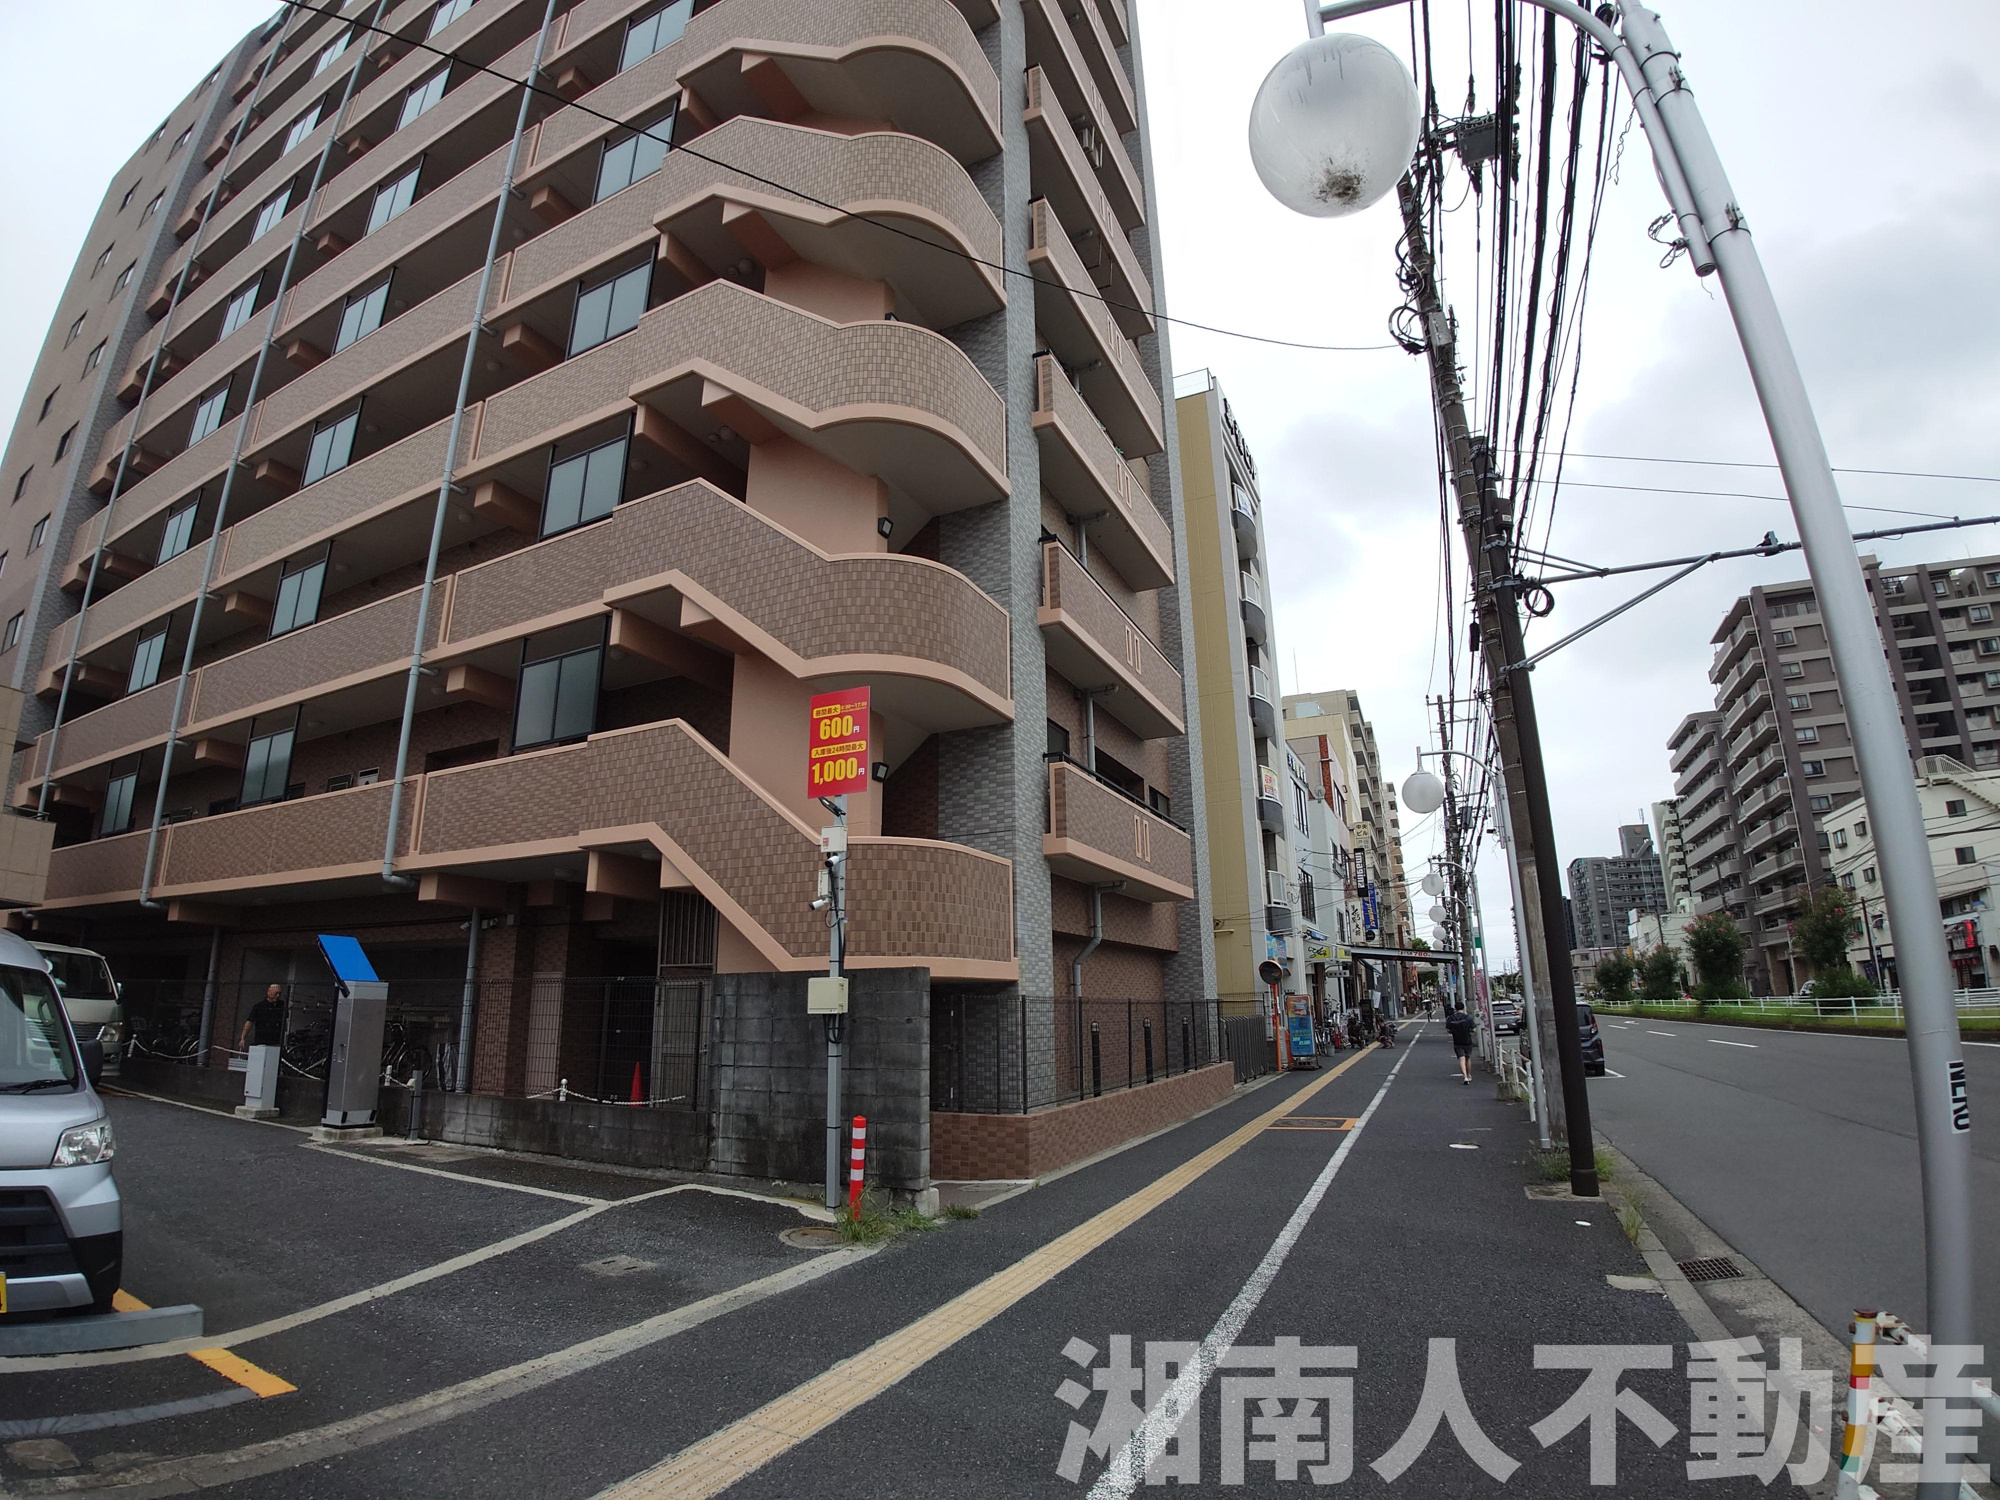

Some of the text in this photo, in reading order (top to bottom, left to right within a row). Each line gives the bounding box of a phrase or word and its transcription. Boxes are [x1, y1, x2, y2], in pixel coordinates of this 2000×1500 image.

[814, 743, 864, 757] 入庫後24時間最大
